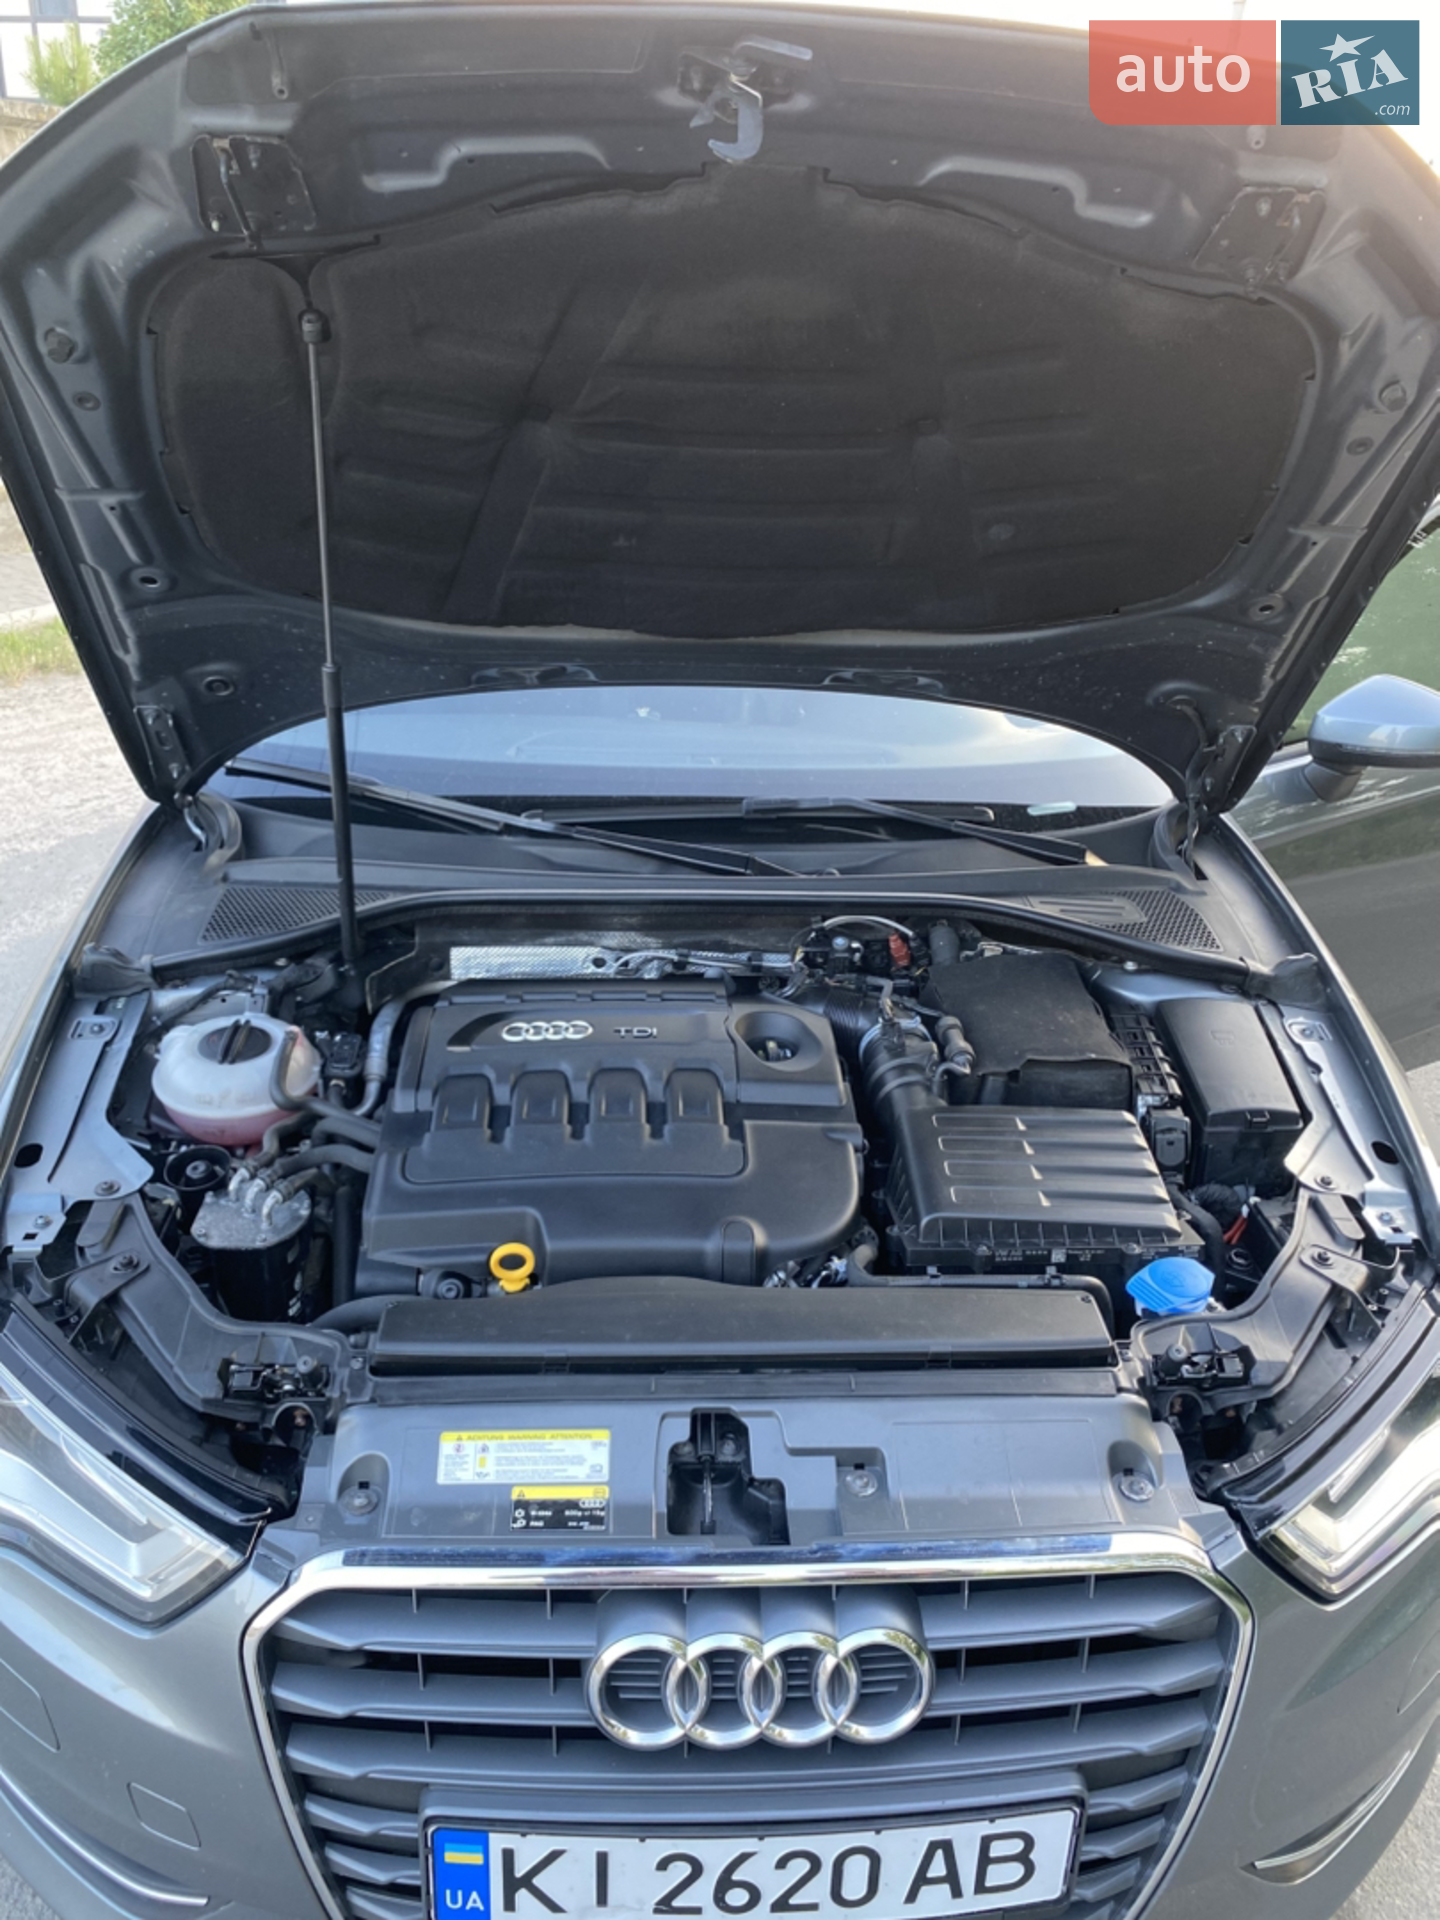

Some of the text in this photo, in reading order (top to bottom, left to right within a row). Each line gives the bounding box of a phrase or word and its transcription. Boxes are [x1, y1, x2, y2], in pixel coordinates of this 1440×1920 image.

[613, 1026, 657, 1039] TDI
[501, 1830, 1036, 1915] KI 2620 AB
[445, 1888, 485, 1911] UA
